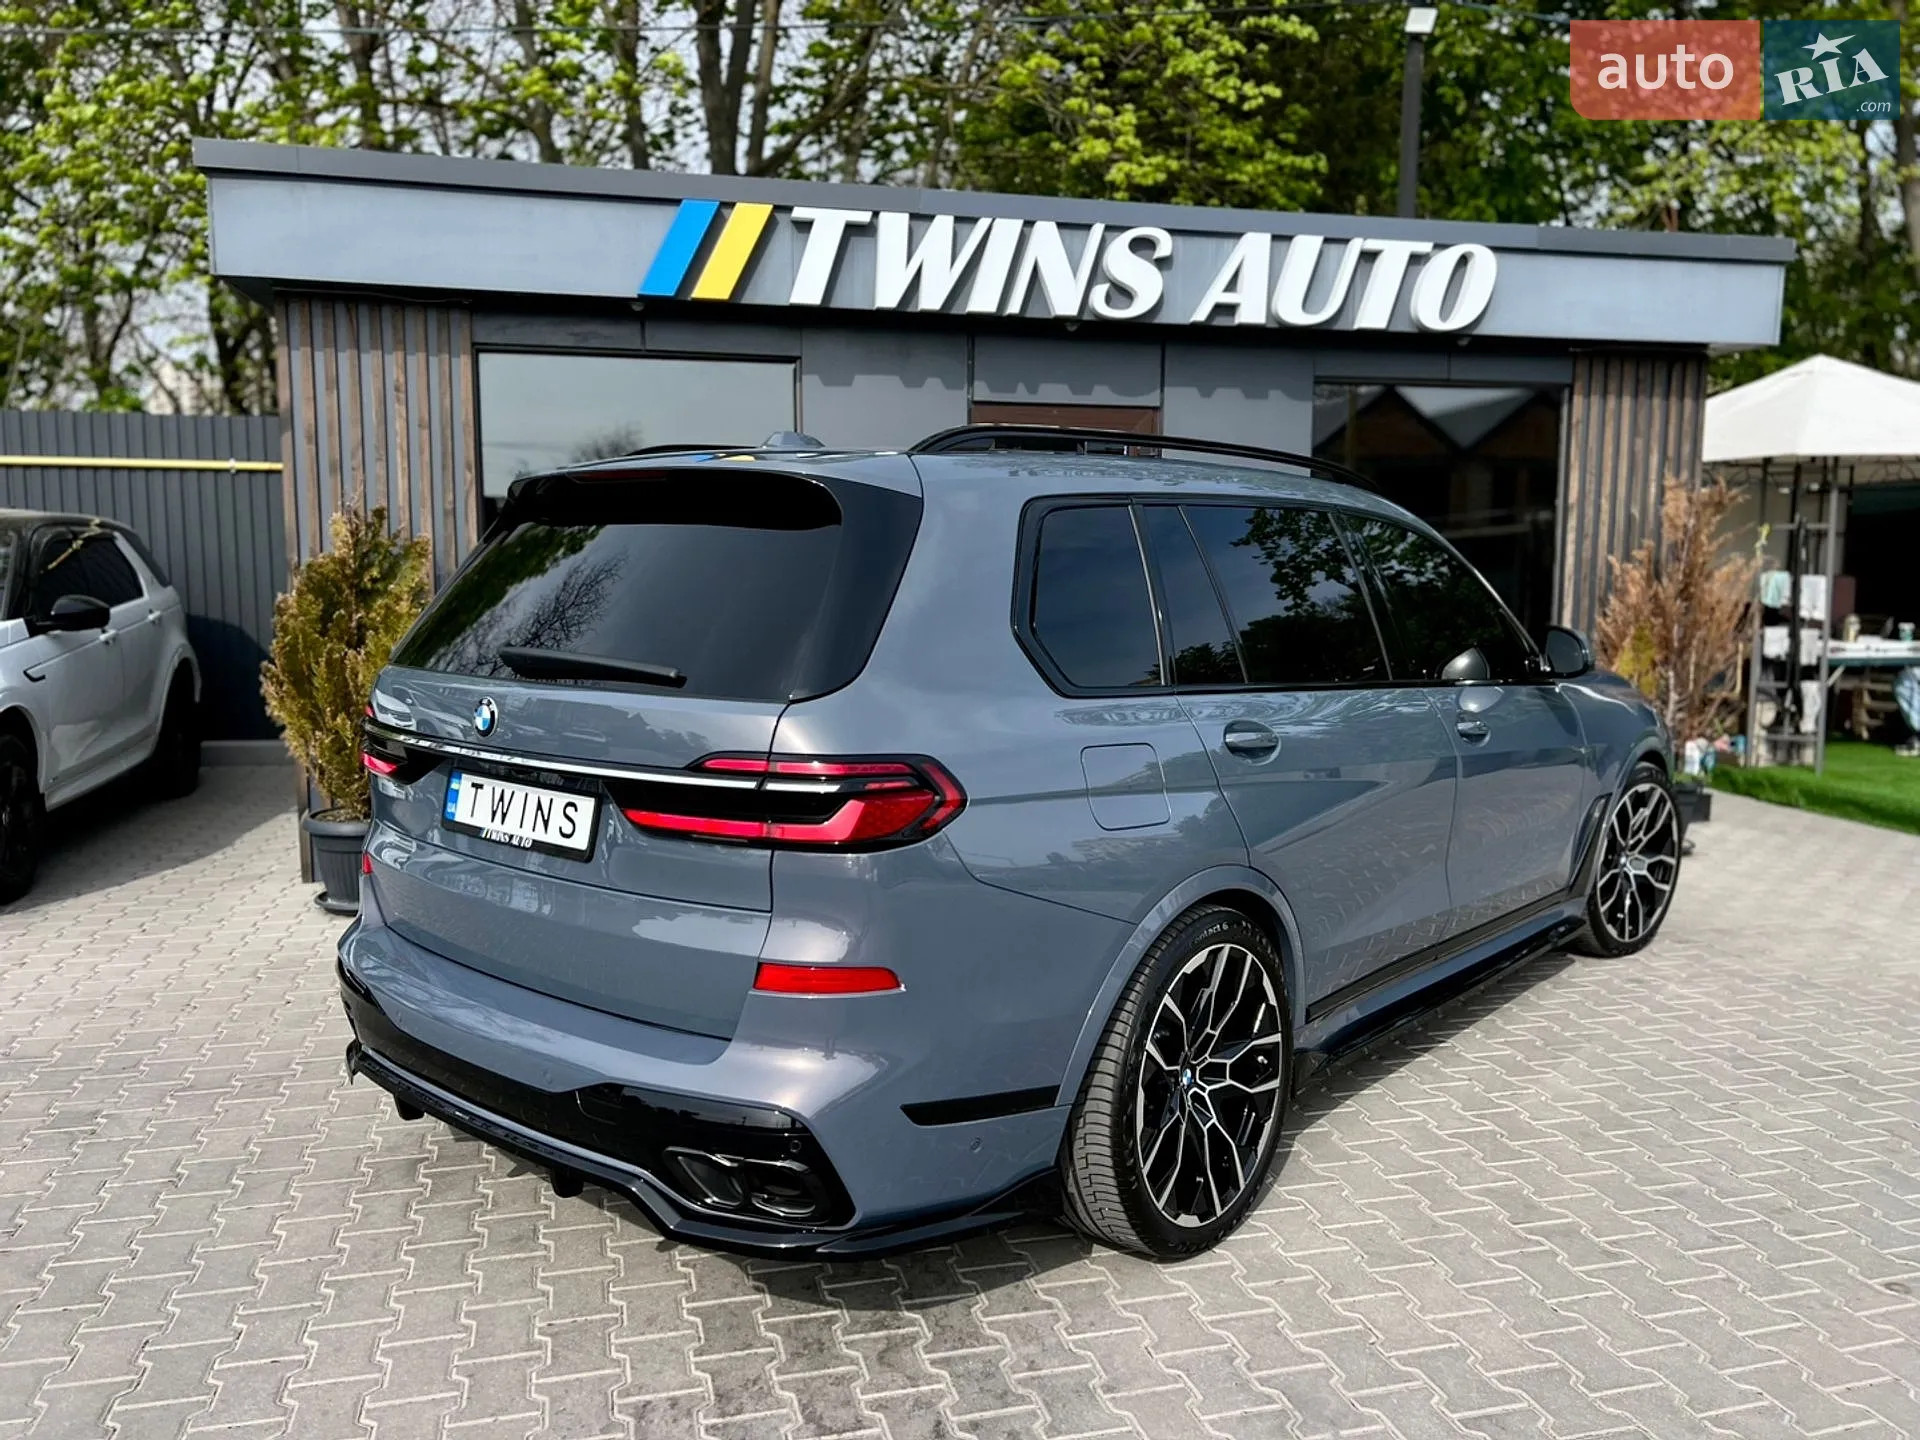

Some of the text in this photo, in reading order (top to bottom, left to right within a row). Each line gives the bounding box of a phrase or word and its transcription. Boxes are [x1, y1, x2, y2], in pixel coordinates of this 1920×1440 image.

[789, 206, 1498, 332] TWINS AUTO
[471, 782, 578, 839] TWINS
